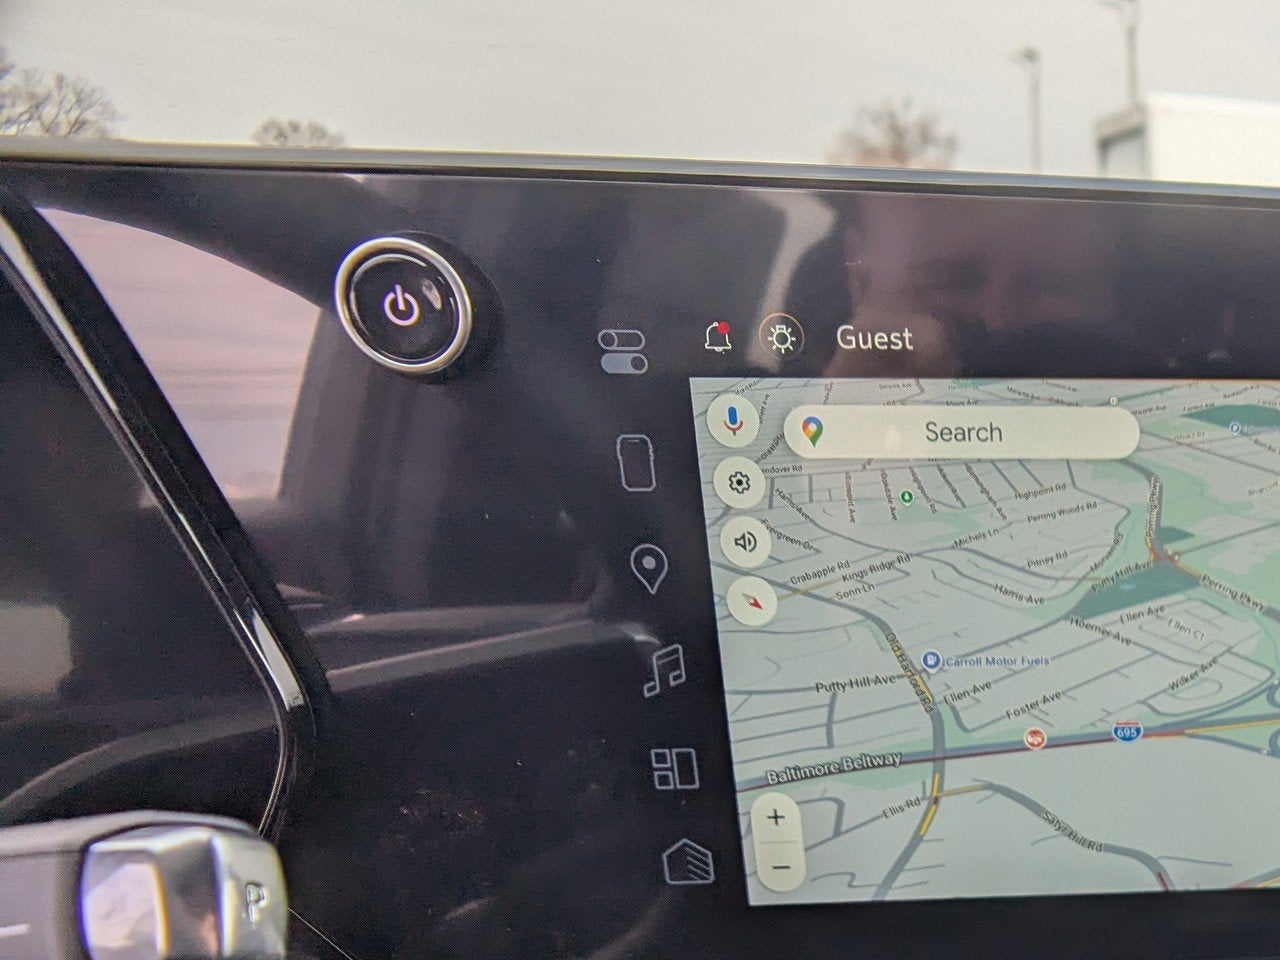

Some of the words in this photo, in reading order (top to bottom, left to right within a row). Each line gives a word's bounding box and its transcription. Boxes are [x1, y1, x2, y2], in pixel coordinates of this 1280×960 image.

[836, 325, 914, 351] Guest
[925, 421, 1003, 443] Search
[761, 465, 791, 475] endover
[792, 465, 803, 473] Rd
[1014, 486, 1052, 502] Highpoint
[1053, 483, 1067, 492] Rd
[888, 505, 899, 521] Ave
[995, 506, 1008, 521] Ave
[1058, 505, 1085, 517] Woods
[1086, 501, 1098, 511] Rd
[761, 518, 803, 547] Evergreen
[953, 532, 986, 549] Michels
[988, 528, 1000, 537] Ln
[838, 559, 850, 571] Rd
[1056, 550, 1068, 561] Rd
[1134, 560, 1152, 571] Ave
[842, 567, 869, 583] Kings
[869, 559, 897, 576] Ridge
[898, 553, 911, 566] Rd
[862, 581, 875, 592] Ln
[994, 583, 1024, 602] Harris
[1026, 593, 1045, 606] Ave
[1201, 574, 1239, 600] Perring
[1239, 591, 1266, 613] Pkwy
[1120, 609, 1145, 624] Ellen
[1146, 604, 1166, 616] Ave
[1069, 616, 1112, 637] Hoerner
[1113, 631, 1133, 646] Ave
[1168, 618, 1192, 635] Ellen
[946, 656, 982, 666] Carroll
[985, 656, 1018, 666] Motor
[1021, 656, 1050, 666] Fuels
[1199, 656, 1219, 673] Ave
[884, 631, 903, 653] Old
[894, 652, 927, 697] Harford
[919, 695, 936, 714] Rd
[814, 681, 846, 693] Putty
[848, 676, 871, 689] Hill
[873, 674, 897, 686] Ave
[943, 688, 970, 705] Ellen
[971, 680, 992, 696] Ave
[1005, 700, 1040, 719] Foster
[1040, 689, 1062, 703] Ave
[1117, 727, 1138, 738] 695
[766, 761, 840, 785] Baltimore
[841, 752, 903, 772] Beltway
[882, 803, 904, 819] Ellis
[906, 796, 921, 808] Rd
[1041, 811, 1069, 835] Satyr
[1067, 829, 1088, 848] Hill
[1086, 840, 1104, 853] Rd
